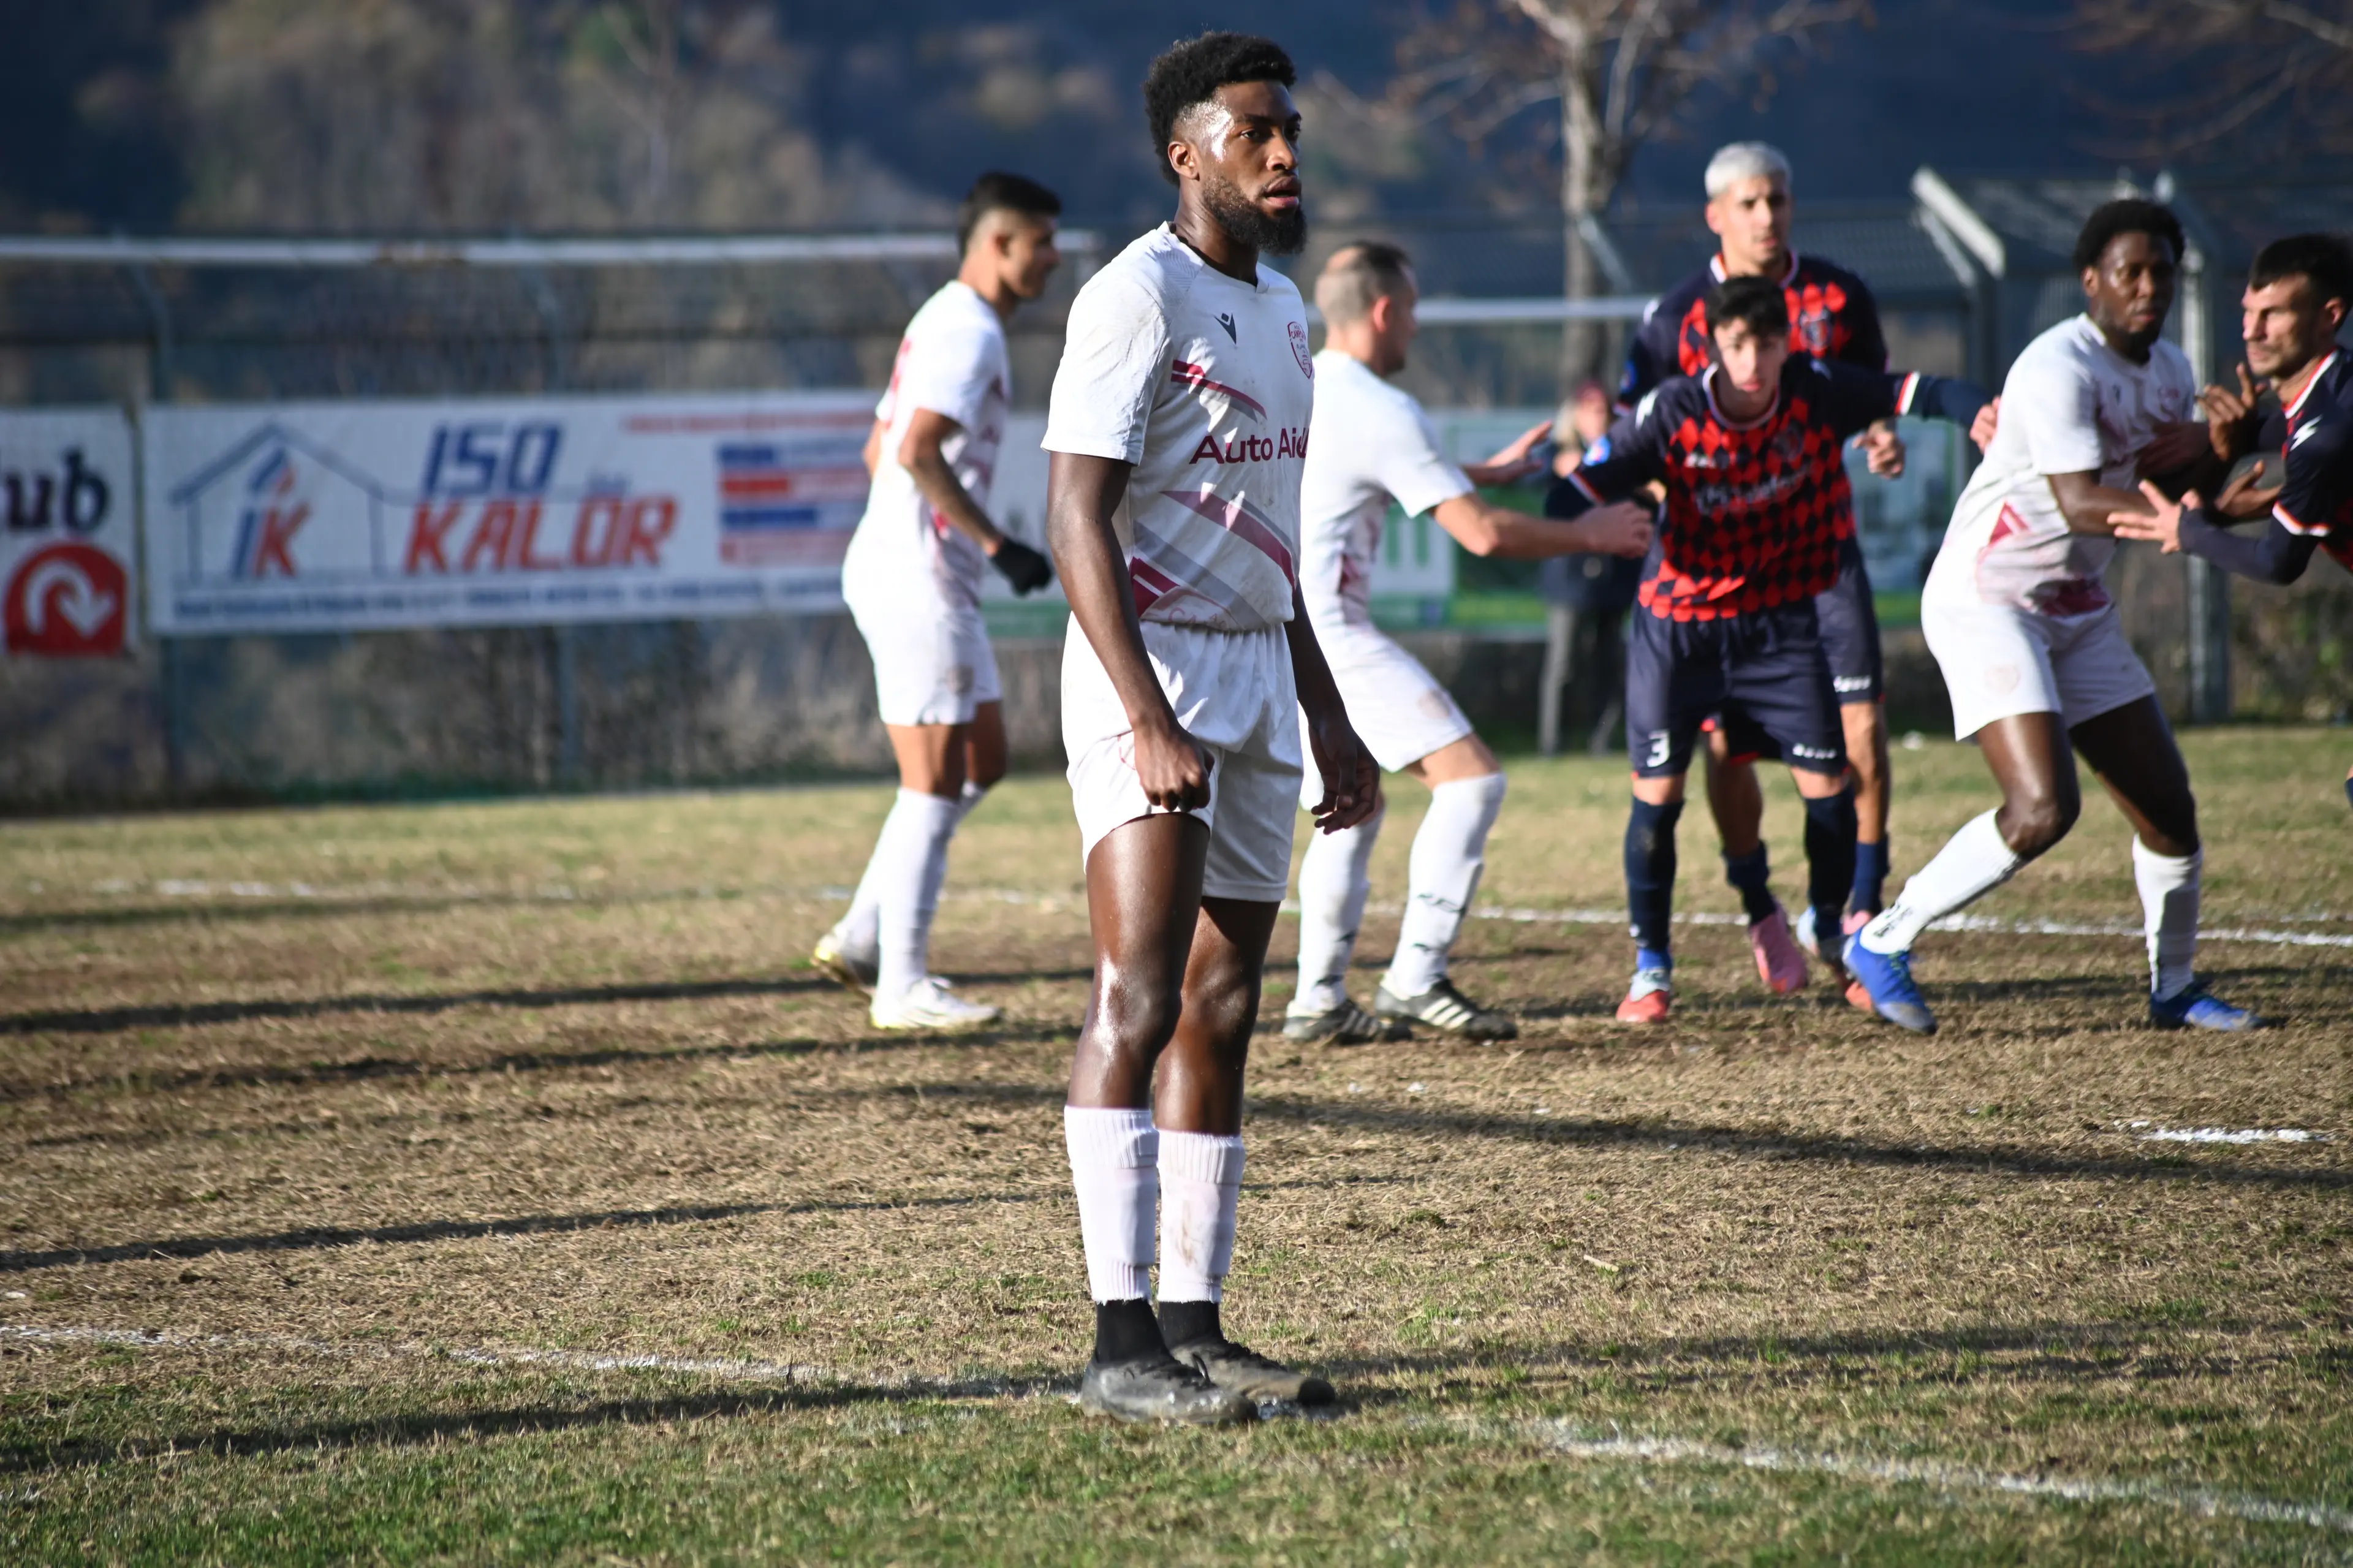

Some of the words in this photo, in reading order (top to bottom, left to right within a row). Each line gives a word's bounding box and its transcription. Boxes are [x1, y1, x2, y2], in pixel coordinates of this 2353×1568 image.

[423, 421, 563, 497] ISO
[1189, 435, 1273, 464] Auto
[4, 447, 110, 531] ub
[405, 494, 677, 575] KALOR
[1646, 730, 1670, 768] 3
